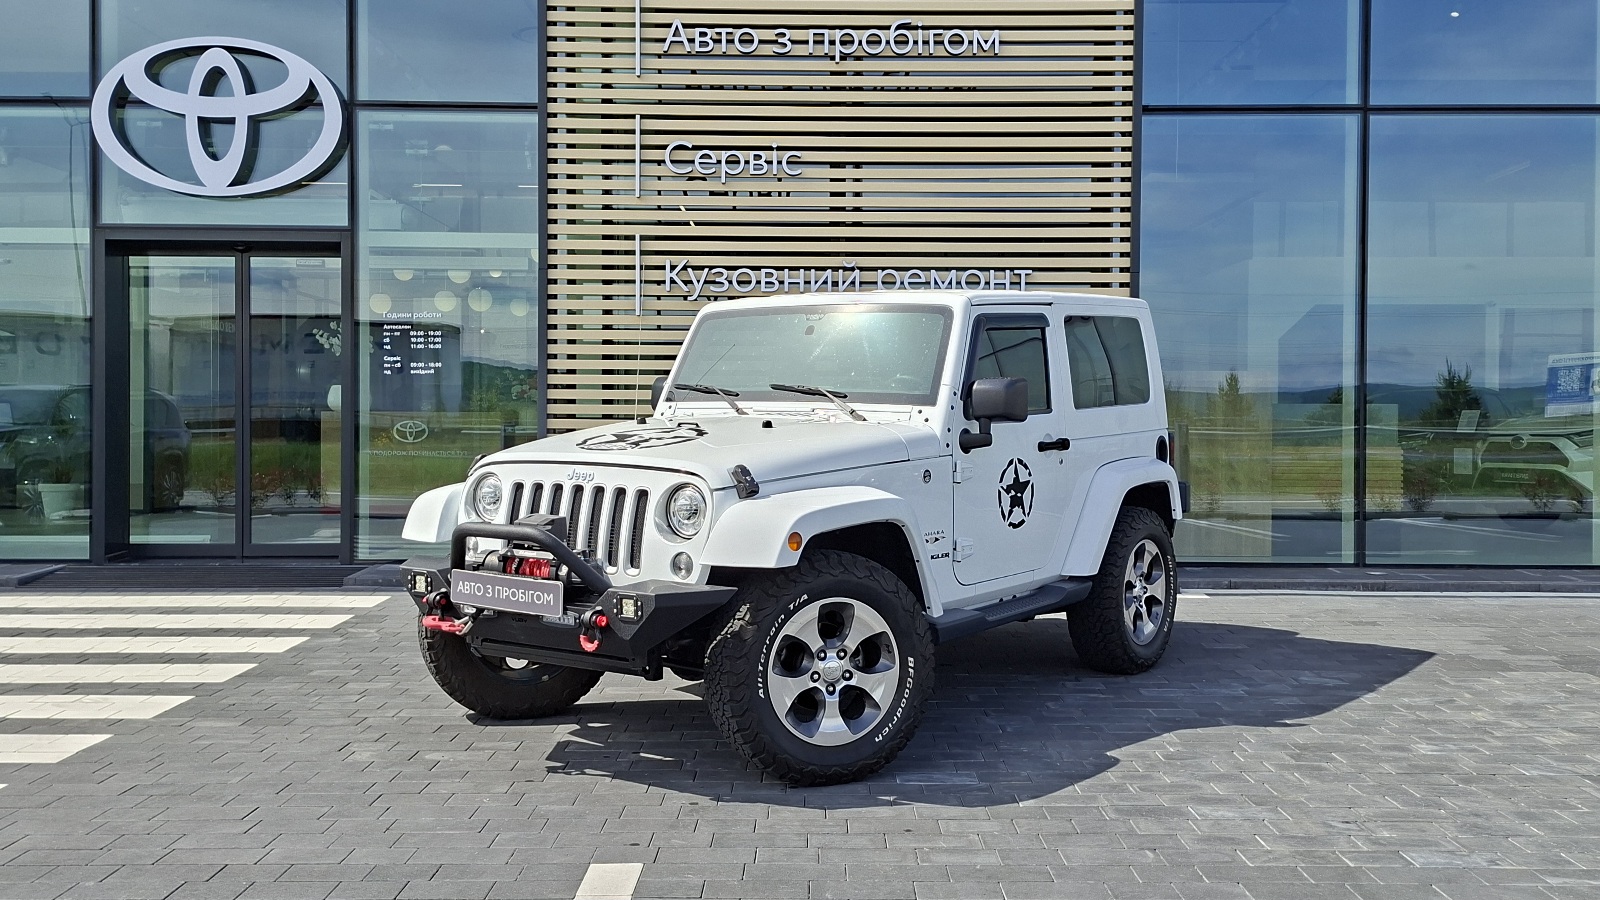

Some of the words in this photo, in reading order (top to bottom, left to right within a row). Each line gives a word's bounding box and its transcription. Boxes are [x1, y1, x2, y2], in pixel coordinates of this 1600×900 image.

[662, 18, 759, 55] Авто
[772, 27, 792, 54] з
[808, 19, 1001, 64] пробігом
[664, 140, 803, 184] Сервіс
[665, 259, 861, 300] Кузовний
[877, 268, 1033, 292] ремонт
[413, 311, 442, 320] роботи
[567, 468, 595, 484] Jeep
[456, 580, 484, 596] АВТО
[494, 585, 554, 606] ПРОБІГОМ
[788, 593, 809, 611] T/A
[874, 656, 915, 742] BFGoodrich
